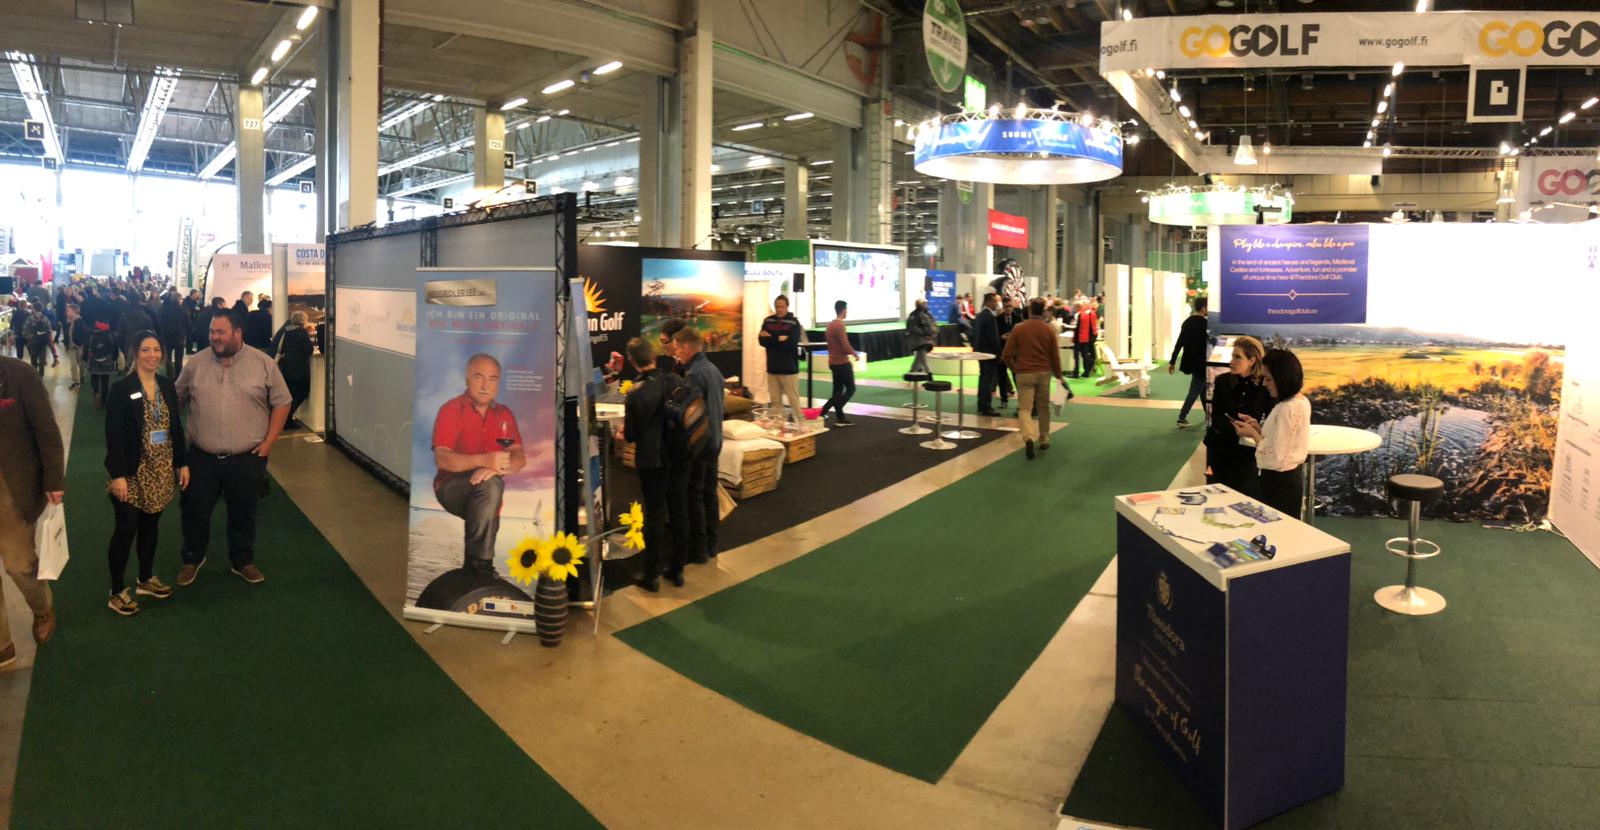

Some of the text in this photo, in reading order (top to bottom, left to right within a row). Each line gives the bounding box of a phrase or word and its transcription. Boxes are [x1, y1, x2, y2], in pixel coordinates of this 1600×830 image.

[1179, 24, 1320, 59] GOGOLF
[1358, 35, 1428, 48] www.gogolf.fi
[297, 249, 318, 259] COSTA
[600, 312, 625, 331] Golf
